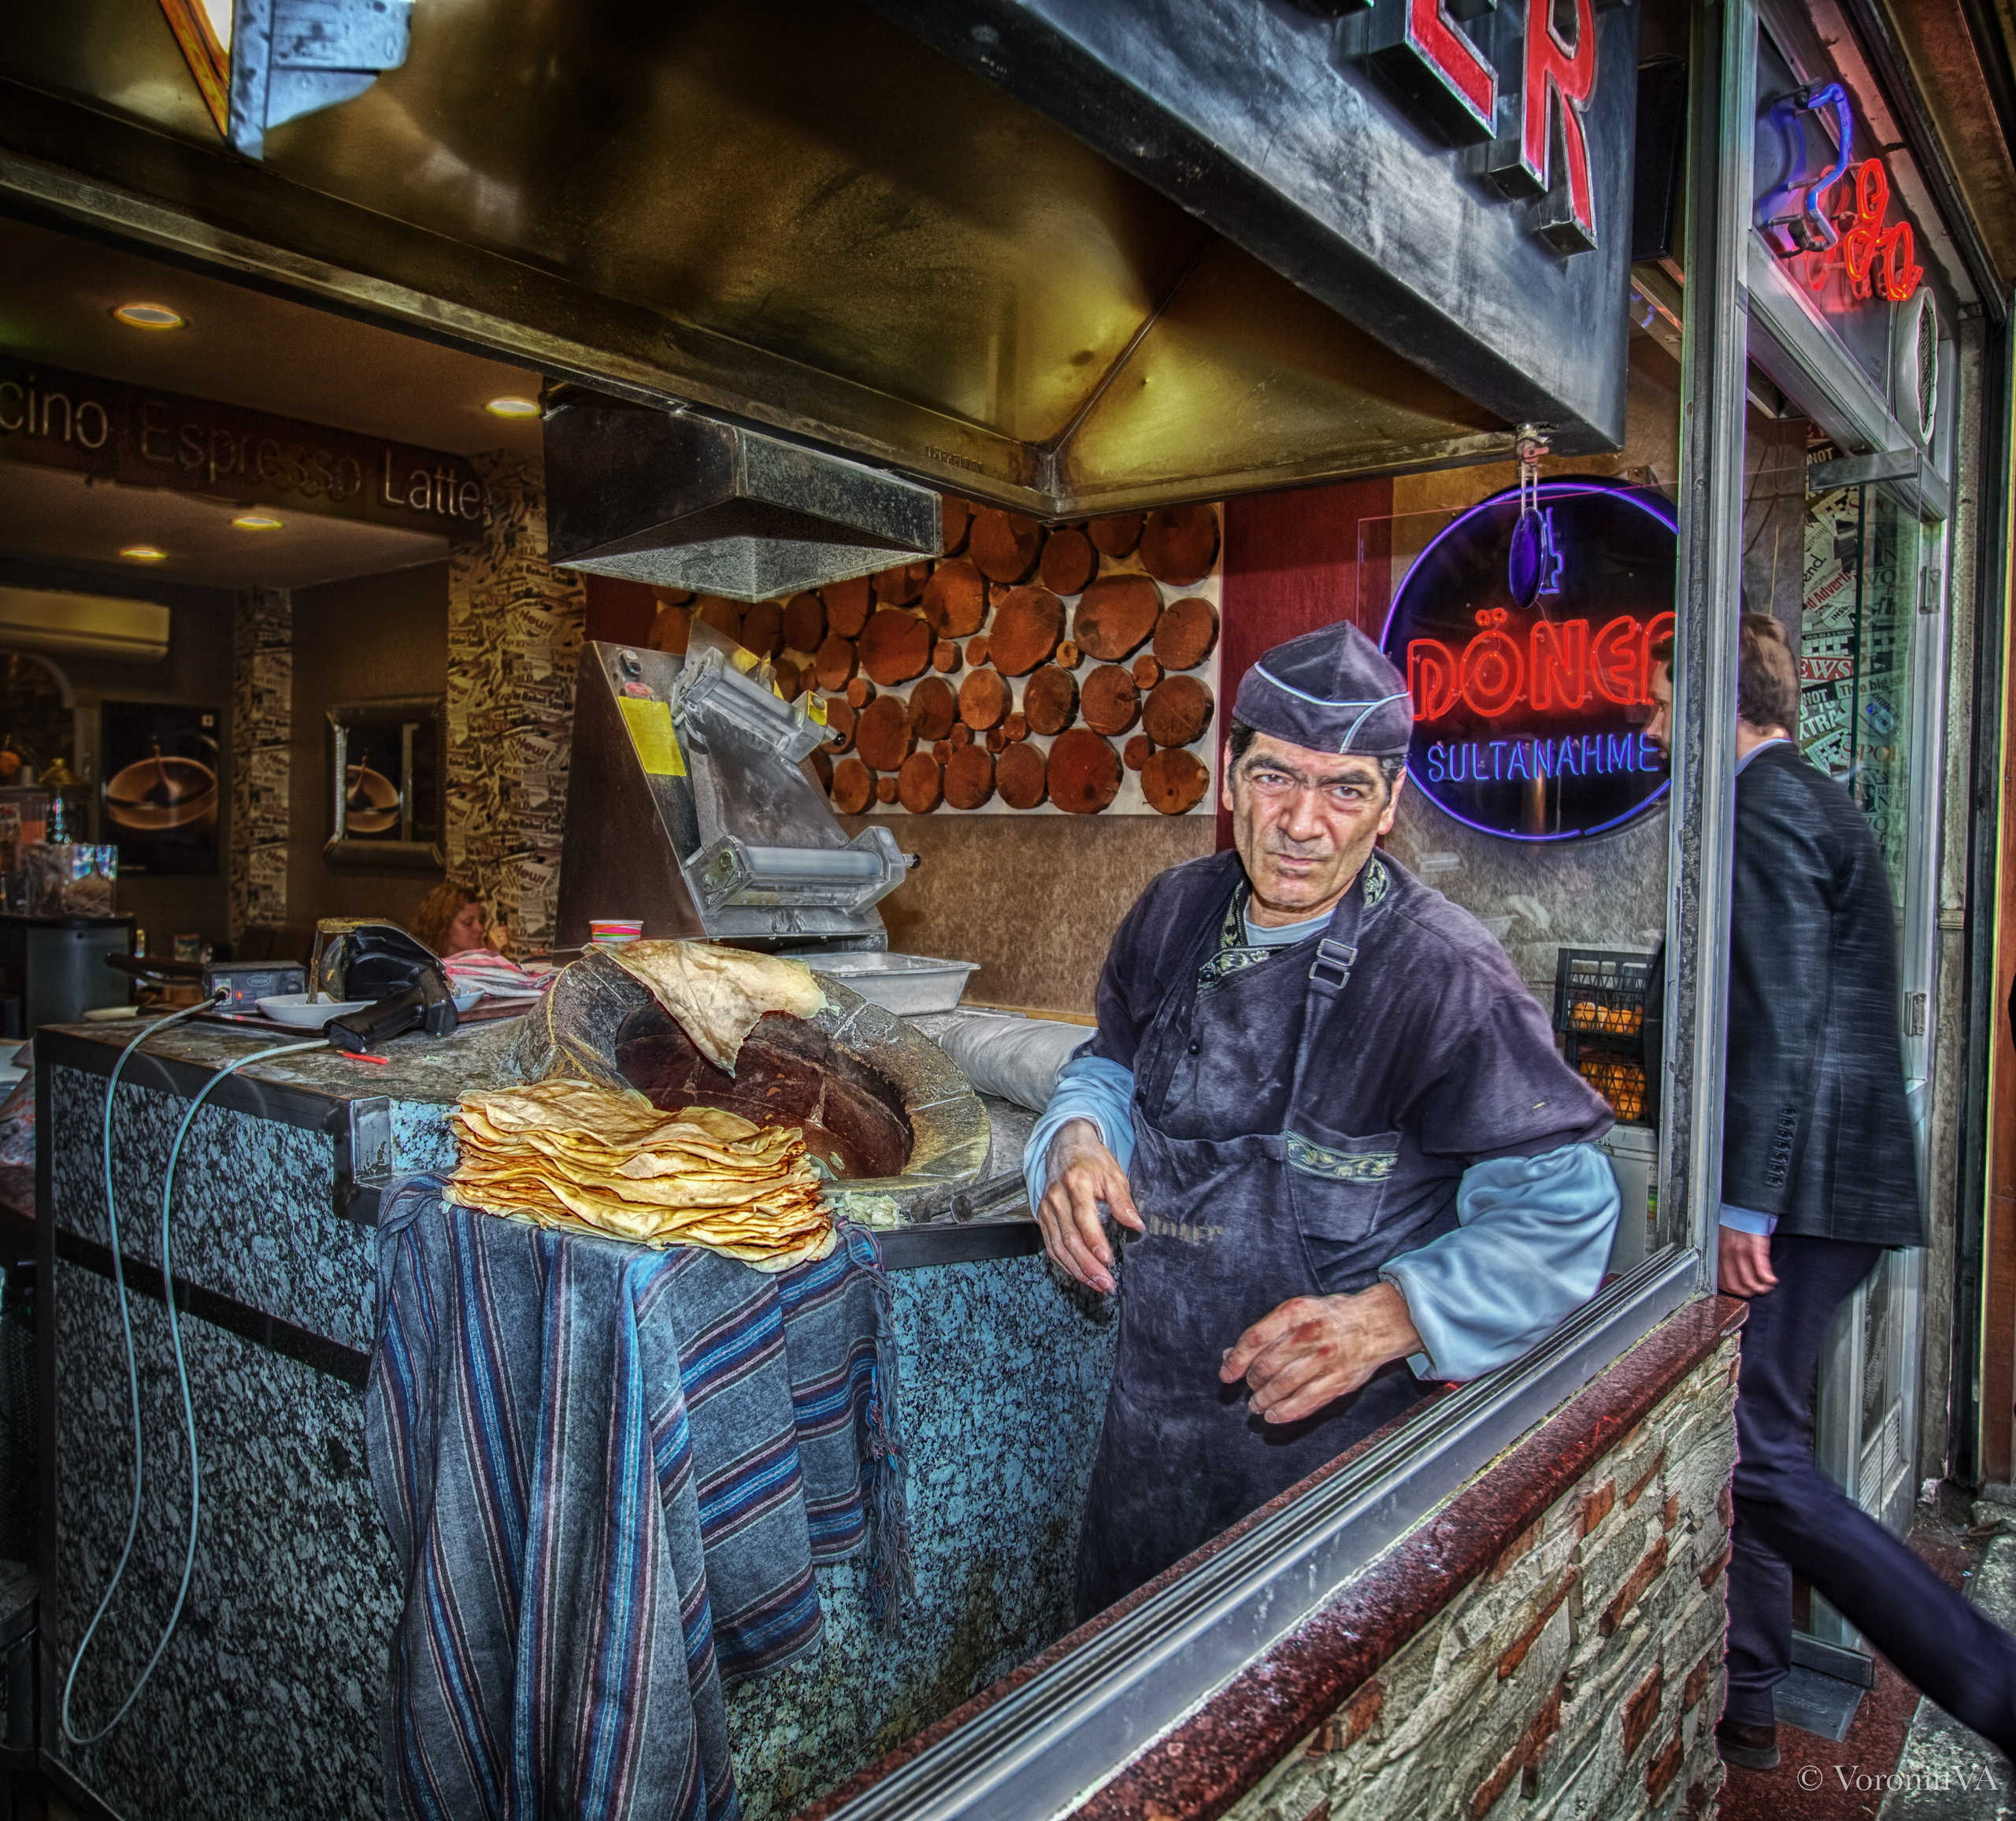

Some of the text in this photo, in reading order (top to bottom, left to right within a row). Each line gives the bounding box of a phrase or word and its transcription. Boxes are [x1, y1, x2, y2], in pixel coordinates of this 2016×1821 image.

[141, 402, 362, 501] Espresso
[384, 448, 481, 520] Latte
[1869, 678, 1890, 691] big
